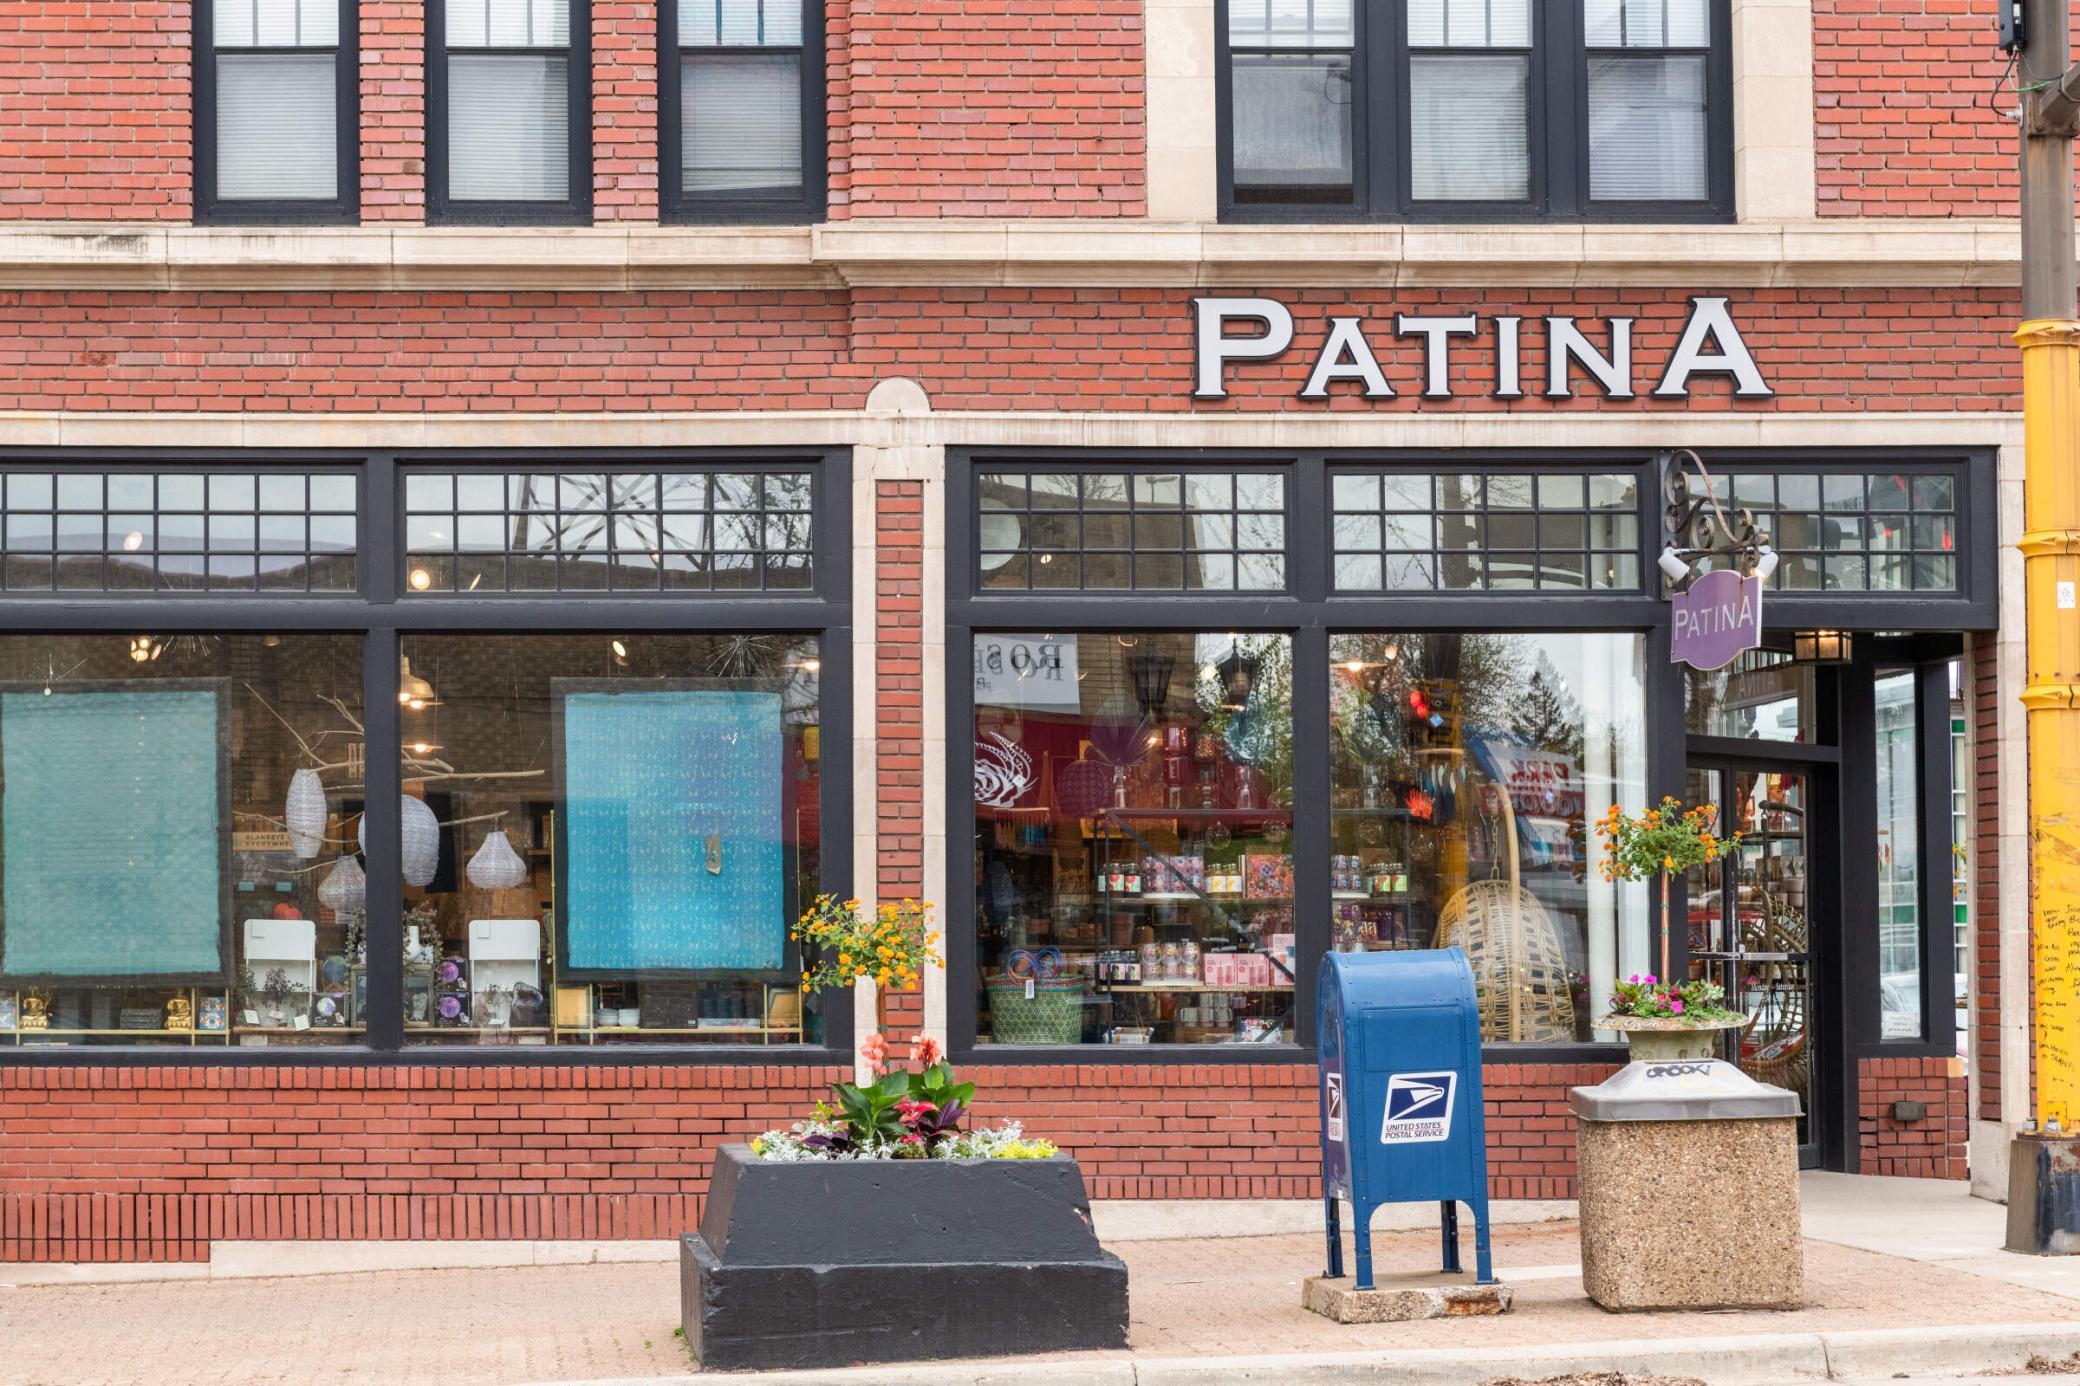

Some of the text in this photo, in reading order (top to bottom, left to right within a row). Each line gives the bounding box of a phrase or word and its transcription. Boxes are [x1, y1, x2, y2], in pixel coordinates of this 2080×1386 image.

[1193, 297, 1775, 398] PATINA
[1674, 595, 1754, 641] PATINA
[1751, 982, 1770, 992] Monday
[1775, 982, 1795, 992] Saturday
[1386, 1121, 1442, 1132] UNITED STATES
[1385, 1129, 1444, 1139] POSTAL SERVICE
